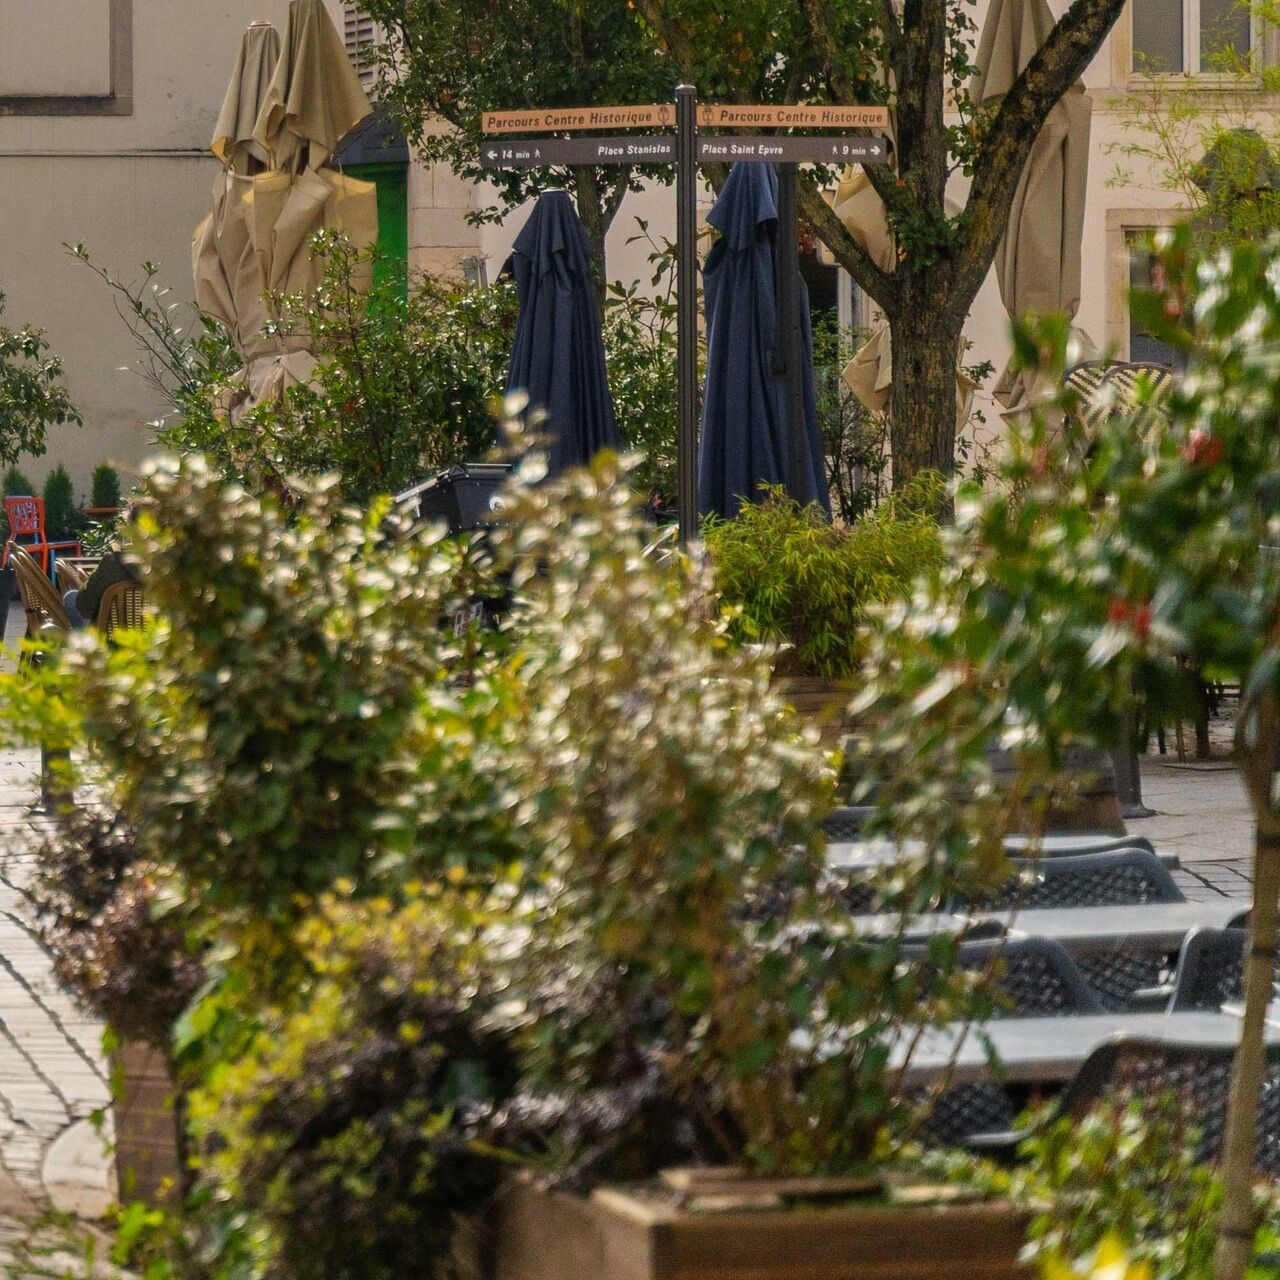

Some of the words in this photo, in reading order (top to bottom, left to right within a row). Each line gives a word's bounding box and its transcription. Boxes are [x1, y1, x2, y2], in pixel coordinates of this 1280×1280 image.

[487, 116, 540, 128] Parcours
[544, 114, 585, 127] Centre
[590, 111, 653, 124] Historique
[720, 110, 773, 122] Parcours
[776, 110, 817, 122] Centre
[821, 110, 883, 124] Historique
[502, 149, 513, 159] 14
[515, 150, 531, 159] min
[598, 145, 624, 156] Place
[627, 144, 671, 155] Stanislas
[702, 144, 728, 154] Place
[730, 144, 755, 155] Saint
[758, 144, 784, 156] Epvre
[842, 145, 849, 155] 9
[851, 147, 866, 155] min
